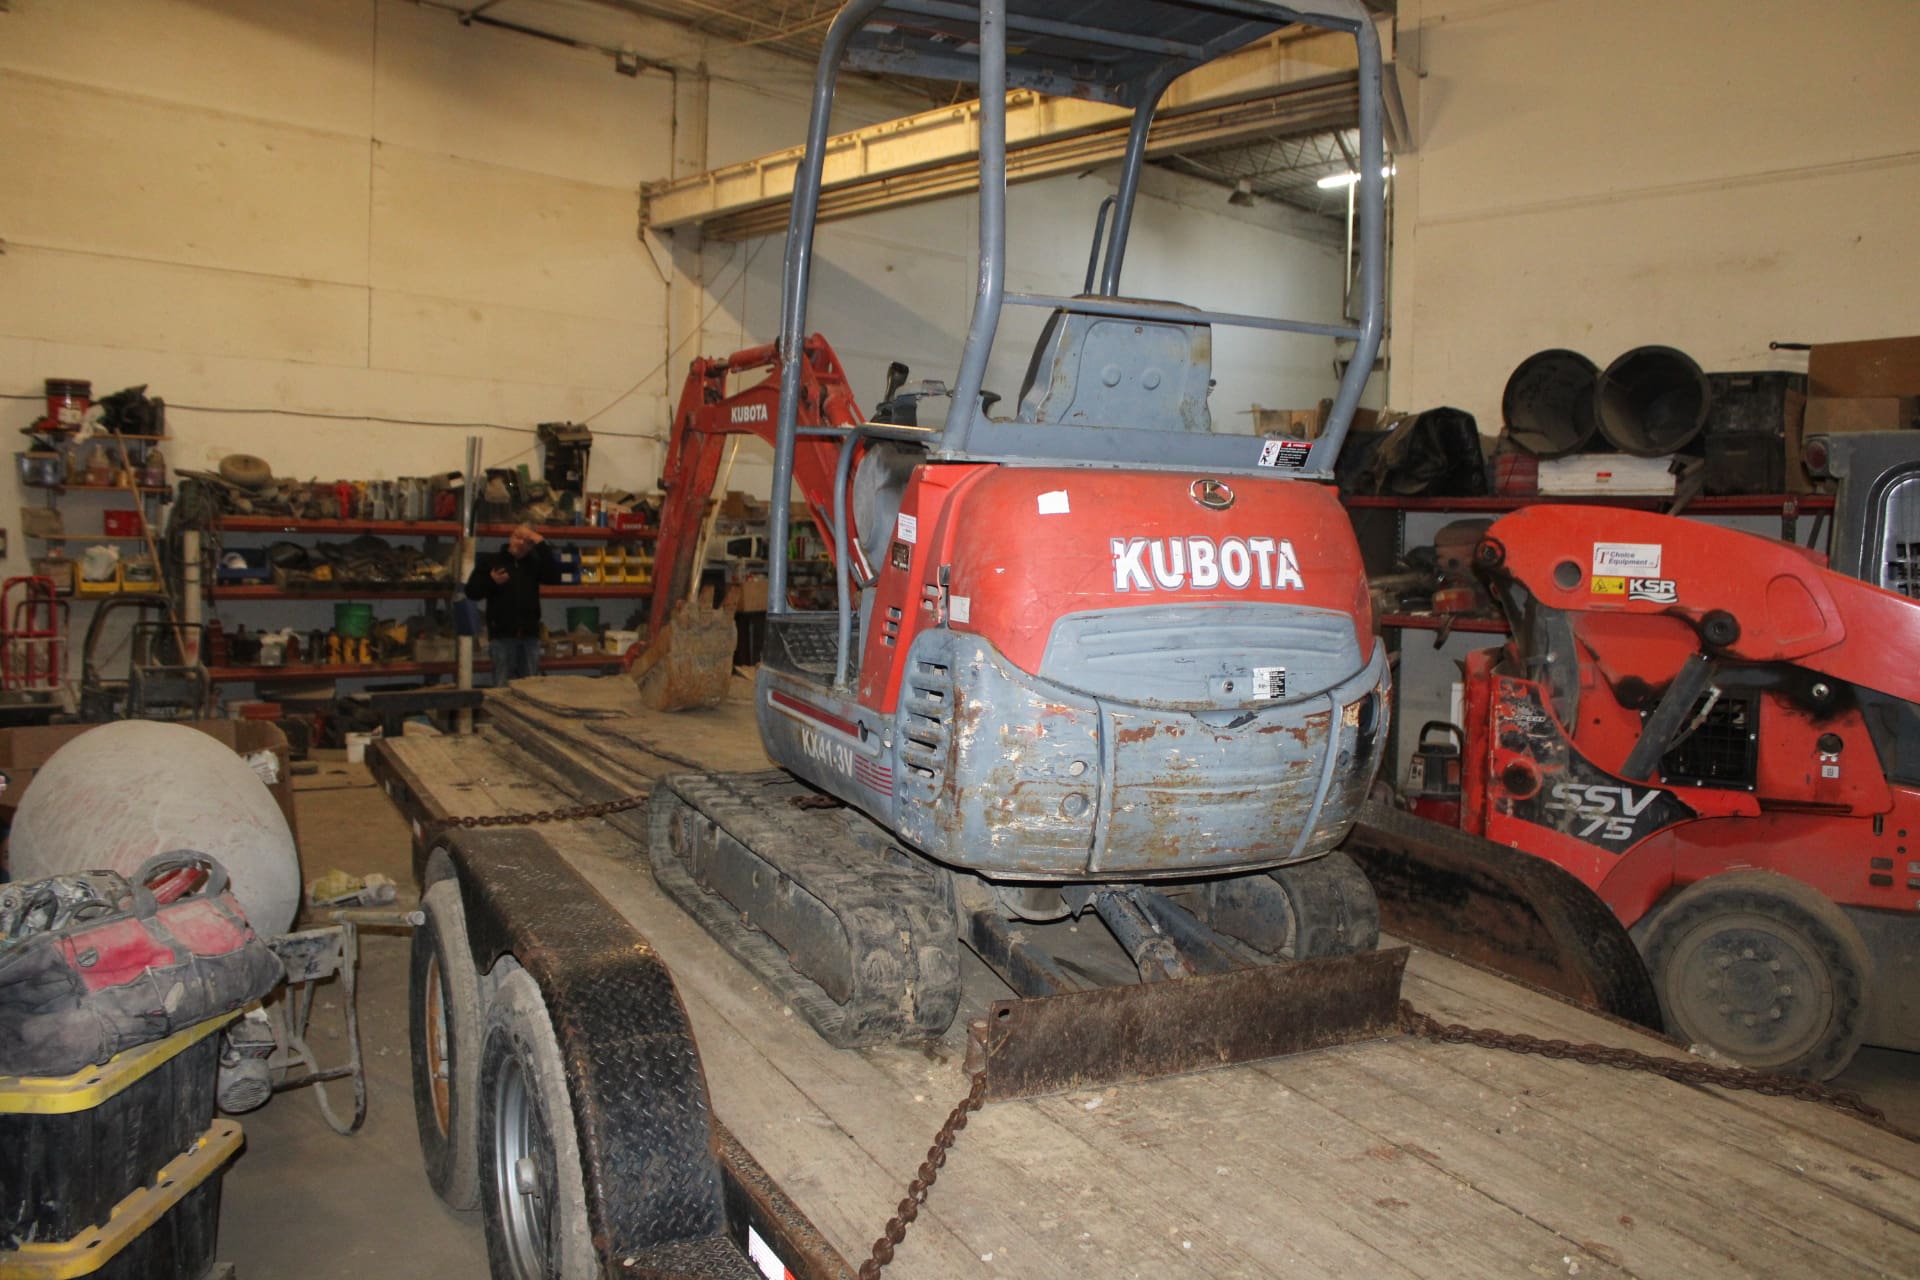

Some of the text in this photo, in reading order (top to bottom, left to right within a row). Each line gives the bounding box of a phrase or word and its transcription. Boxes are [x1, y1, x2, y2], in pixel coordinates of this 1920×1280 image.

[731, 403, 768, 424] KUBOTA
[1111, 536, 1305, 592] KUBOTA
[1608, 558, 1648, 566] Equipment
[1610, 551, 1635, 559] Choice
[1629, 579, 1676, 593] KSR
[1544, 783, 1661, 816] SSV
[1577, 815, 1636, 840] 75
